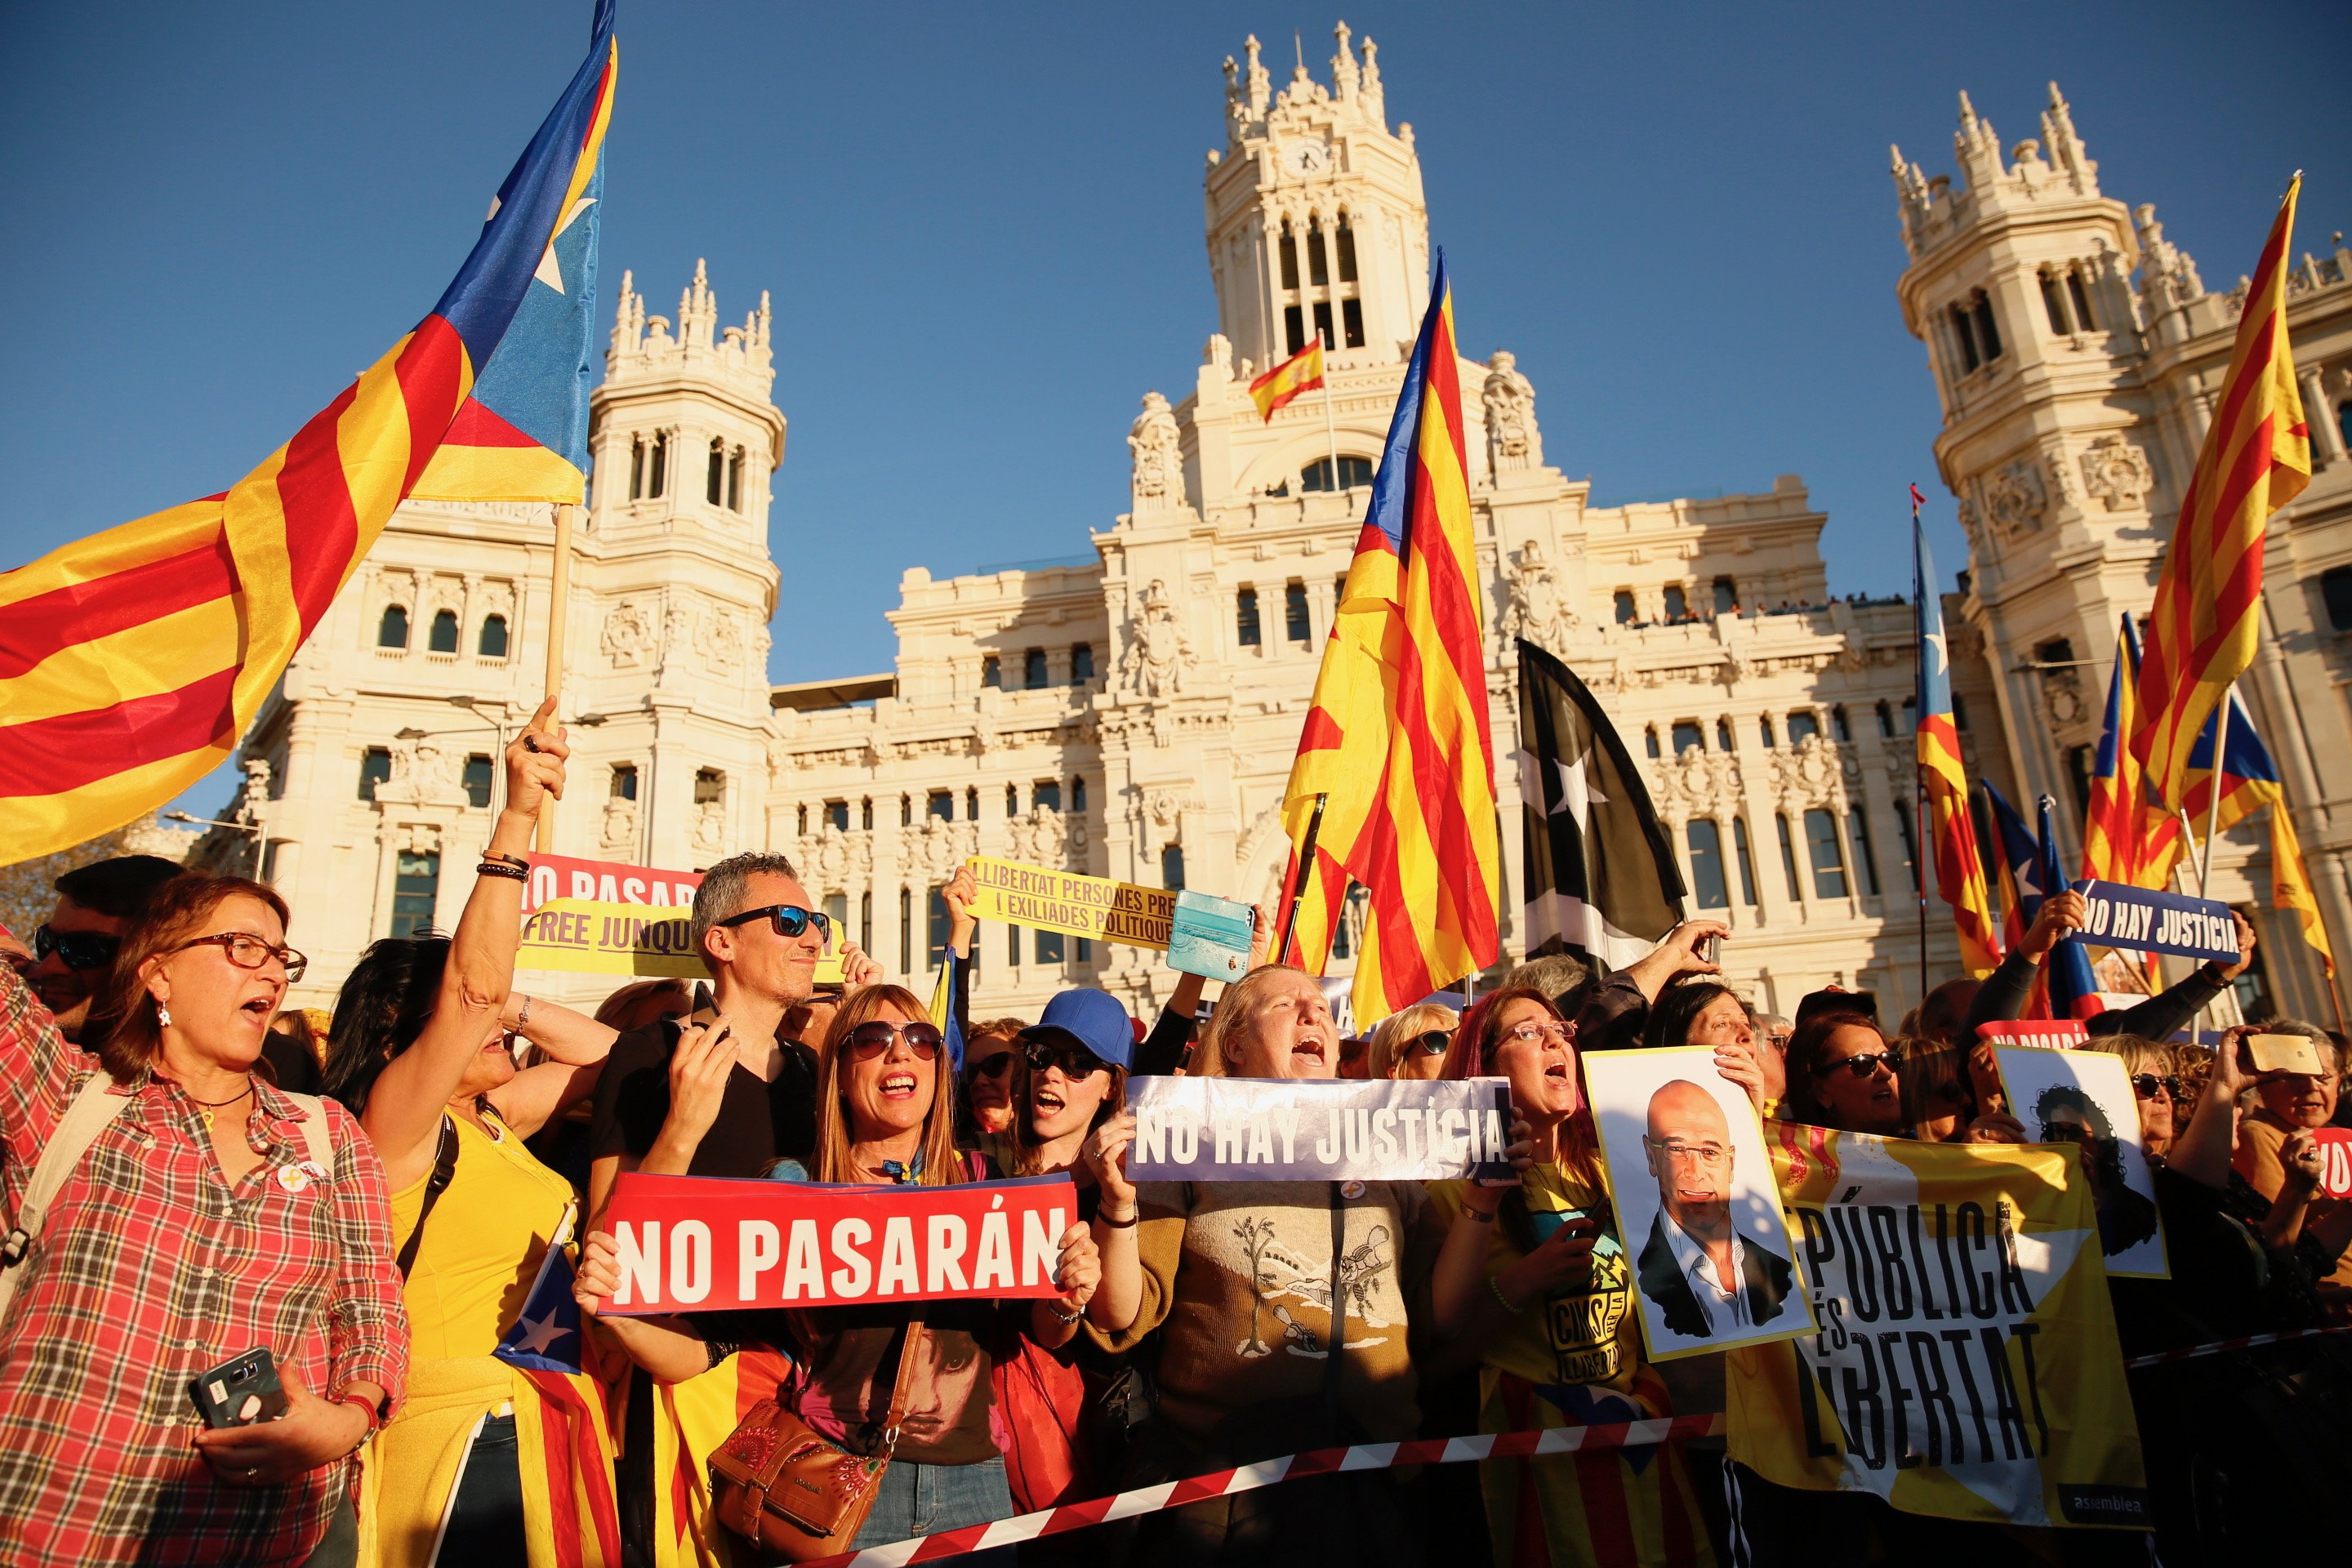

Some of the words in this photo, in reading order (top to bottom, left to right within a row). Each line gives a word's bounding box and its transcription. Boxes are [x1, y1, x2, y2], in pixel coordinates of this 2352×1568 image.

[973, 862, 1057, 896] LLIBERTAT
[1062, 879, 1143, 911] PERSONES
[523, 911, 590, 945] FREE
[599, 915, 695, 954] JUNQU
[996, 893, 1001, 911] I
[1009, 895, 1089, 928] EXILIADES
[2077, 898, 2109, 935] NO
[2111, 901, 2154, 942] HAY
[2156, 906, 2239, 954] JUSTÍCIA
[1135, 1107, 1199, 1164] NO
[1214, 1107, 1302, 1164] HAY
[1316, 1097, 1509, 1164] JUSTÍCIA
[613, 1220, 711, 1305] NO
[738, 1194, 1065, 1302] PASARÁN
[1784, 1186, 2036, 1323] PÚBLICA
[1556, 1298, 1602, 1344] CIMS
[1607, 1315, 1618, 1334] PER
[1611, 1297, 1624, 1310] LA
[1813, 1291, 1847, 1357] ÉS
[2074, 1495, 2141, 1512] assemblea
